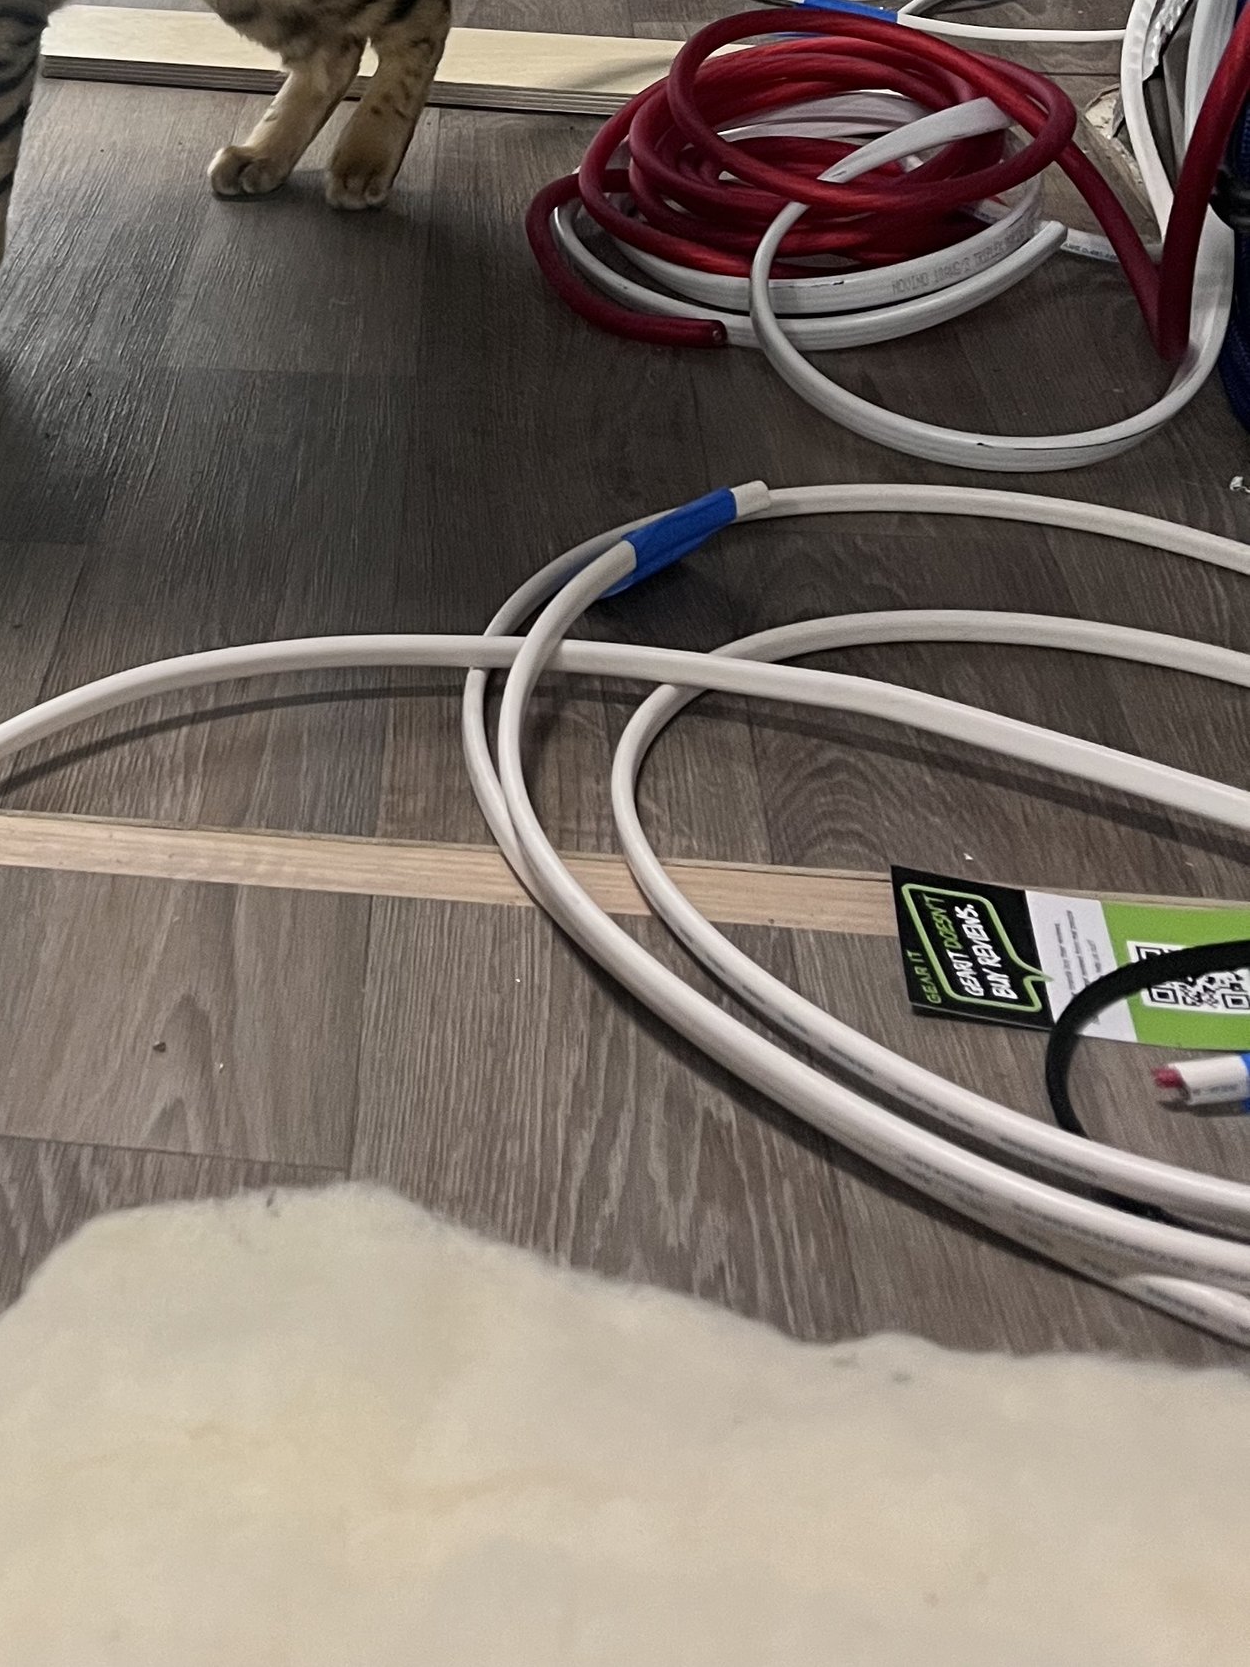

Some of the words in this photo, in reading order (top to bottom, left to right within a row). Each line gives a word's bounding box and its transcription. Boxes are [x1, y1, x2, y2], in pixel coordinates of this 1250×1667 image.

[906, 948, 925, 964] IT
[914, 965, 942, 1004] GEAR
[981, 967, 1019, 1000] BUY
